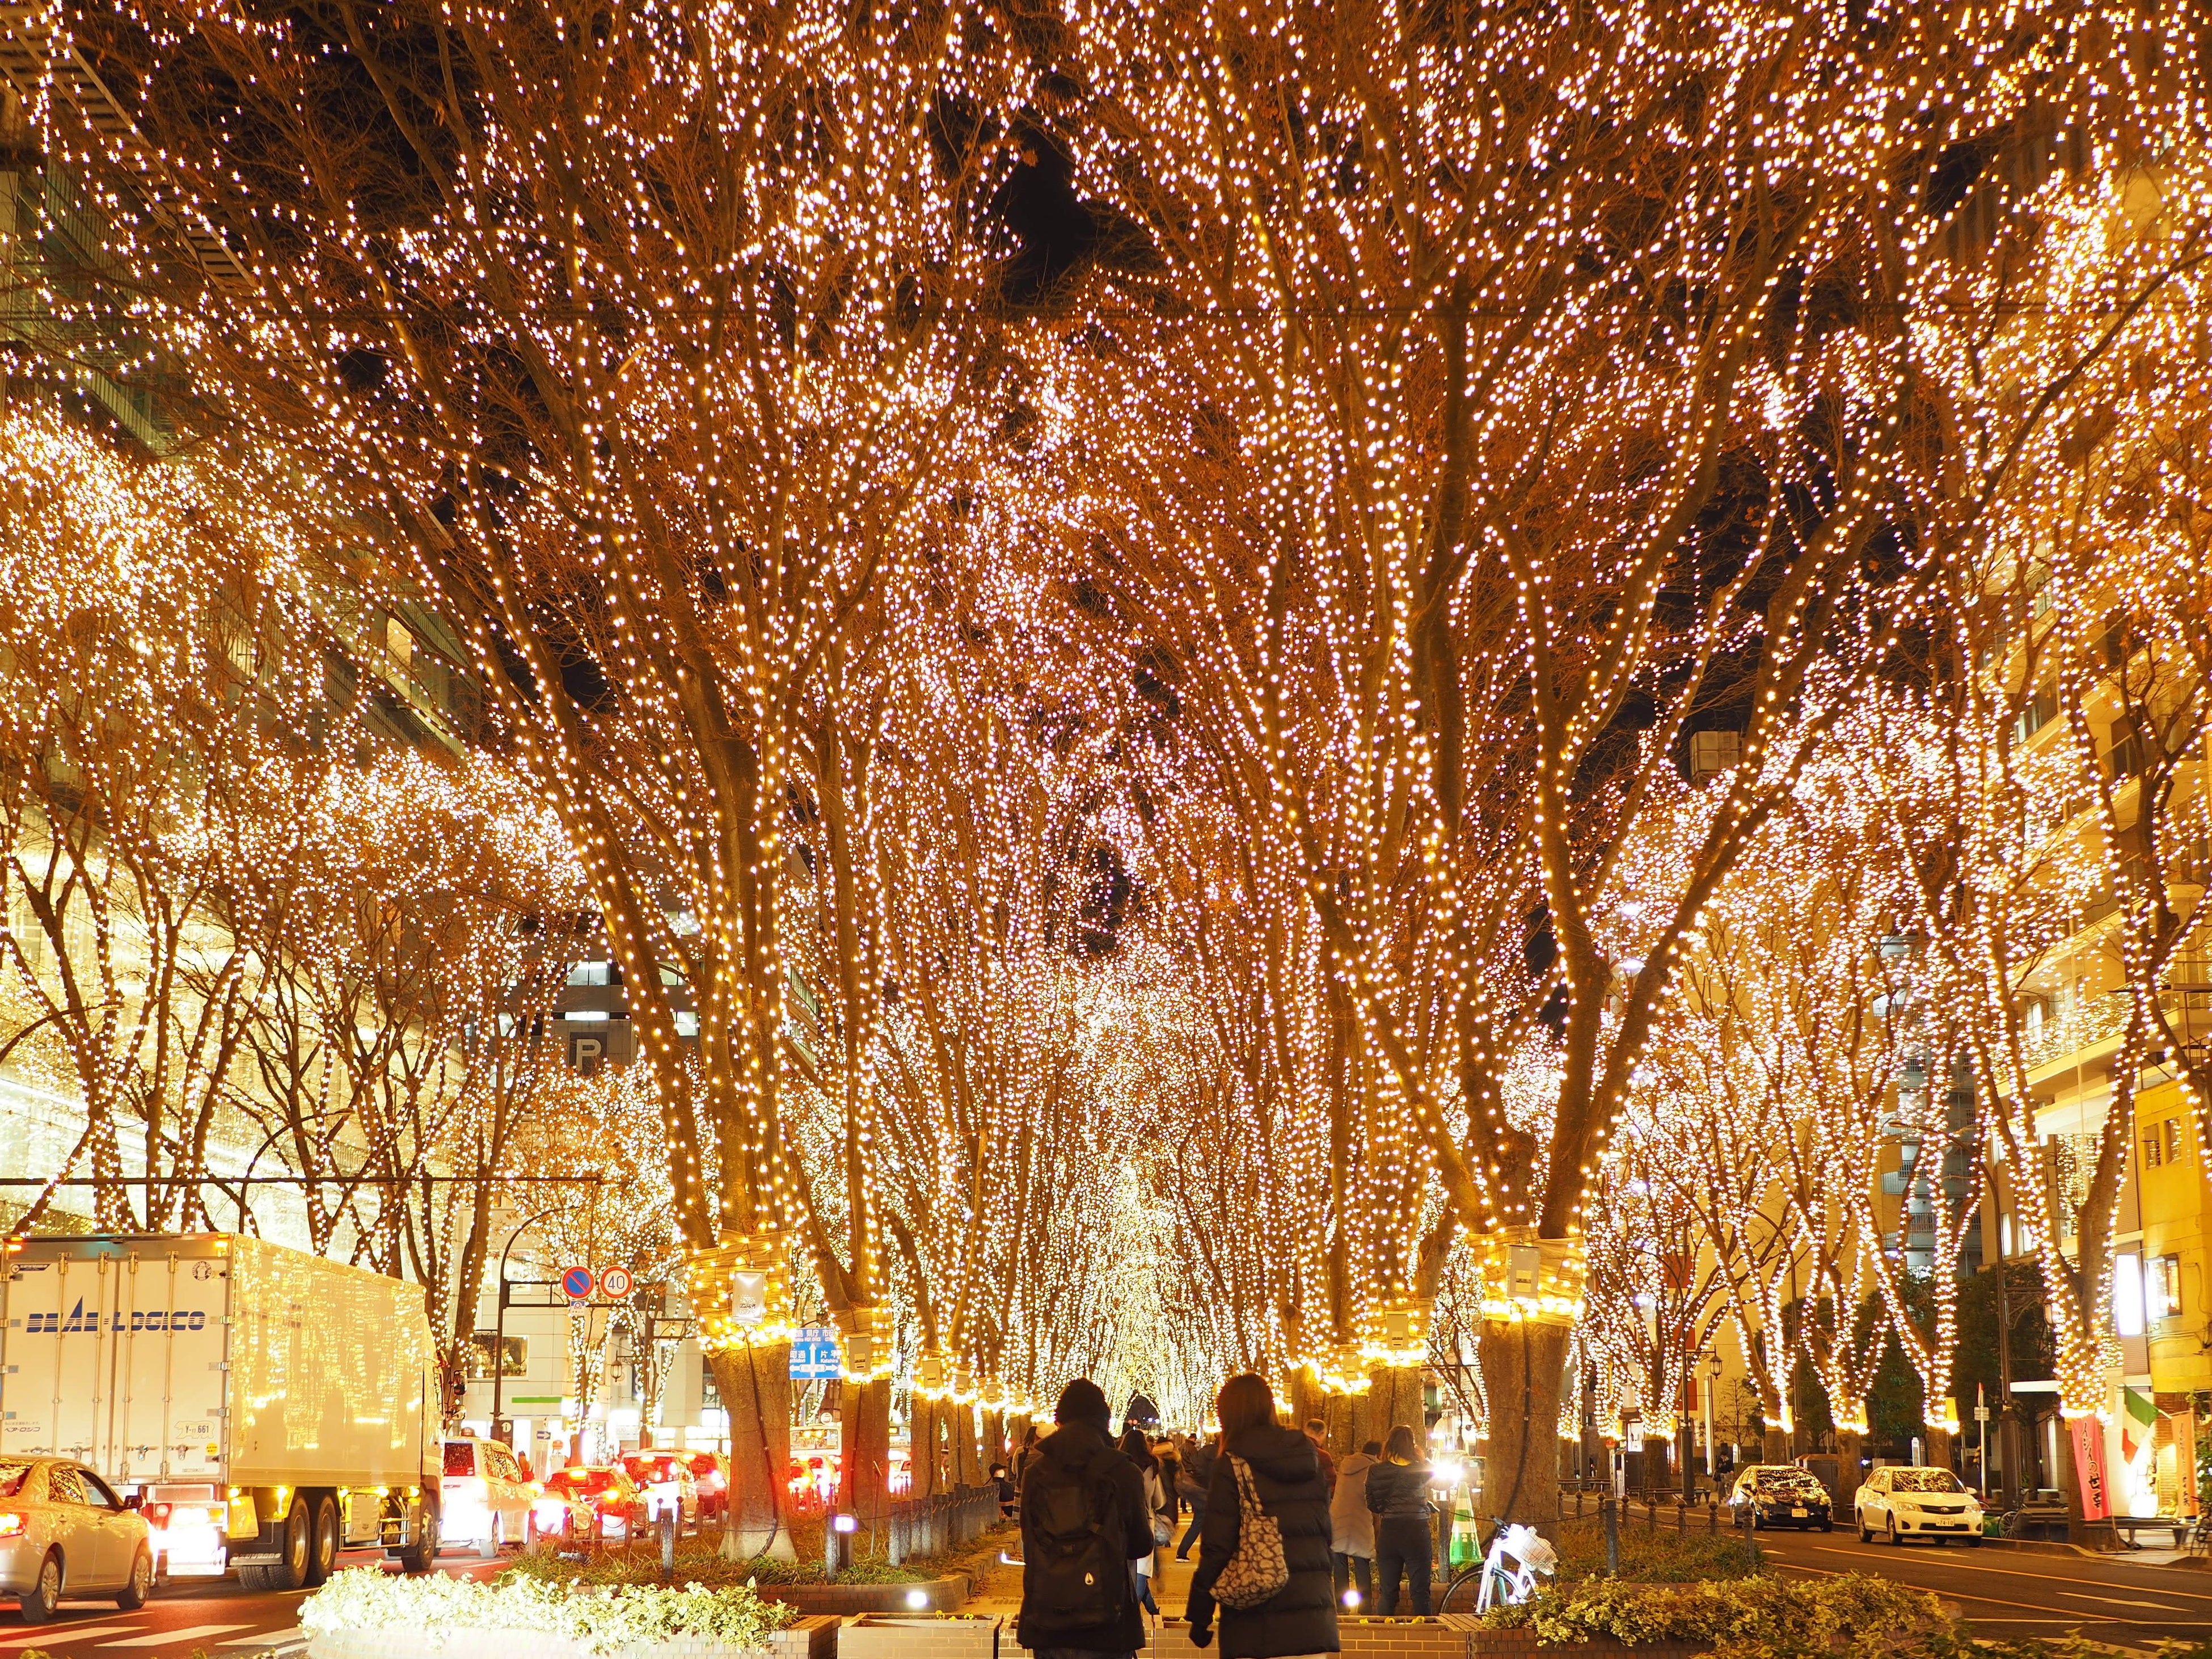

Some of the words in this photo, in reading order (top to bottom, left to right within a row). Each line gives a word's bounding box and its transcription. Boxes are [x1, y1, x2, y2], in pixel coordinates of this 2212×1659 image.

[576, 1039, 601, 1071] P
[607, 1275, 624, 1289] 40
[197, 1425, 209, 1433] 661
